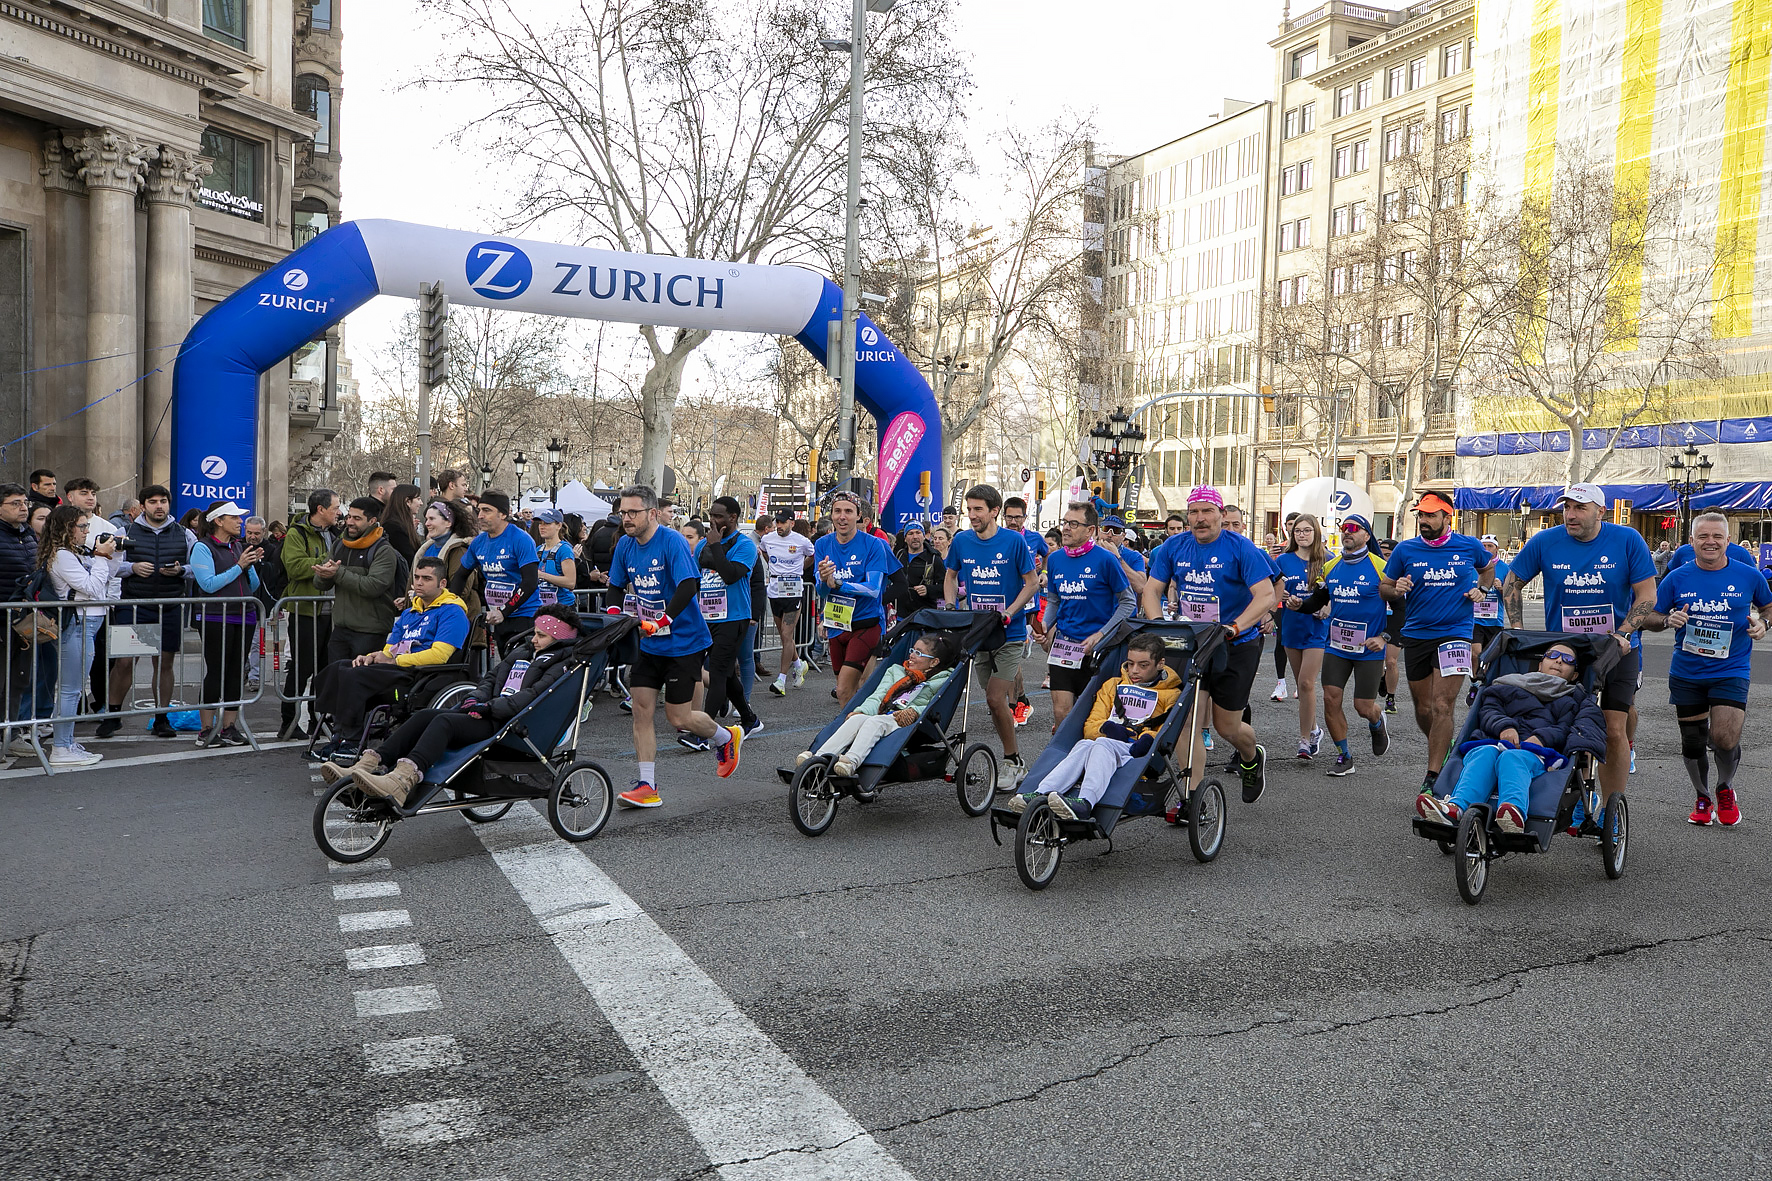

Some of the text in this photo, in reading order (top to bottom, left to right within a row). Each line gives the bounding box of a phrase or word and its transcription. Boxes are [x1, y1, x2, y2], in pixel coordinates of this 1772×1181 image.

[551, 262, 724, 309] ZURICH
[258, 293, 328, 314] ZURICH
[855, 350, 896, 362] URICH
[886, 421, 919, 472] aefat
[181, 482, 247, 500] ZURICH
[1569, 616, 1608, 627] GONZALO
[1340, 629, 1355, 638] FEDE
[1694, 628, 1721, 640] MANEL
[1053, 642, 1072, 651] CARLOS
